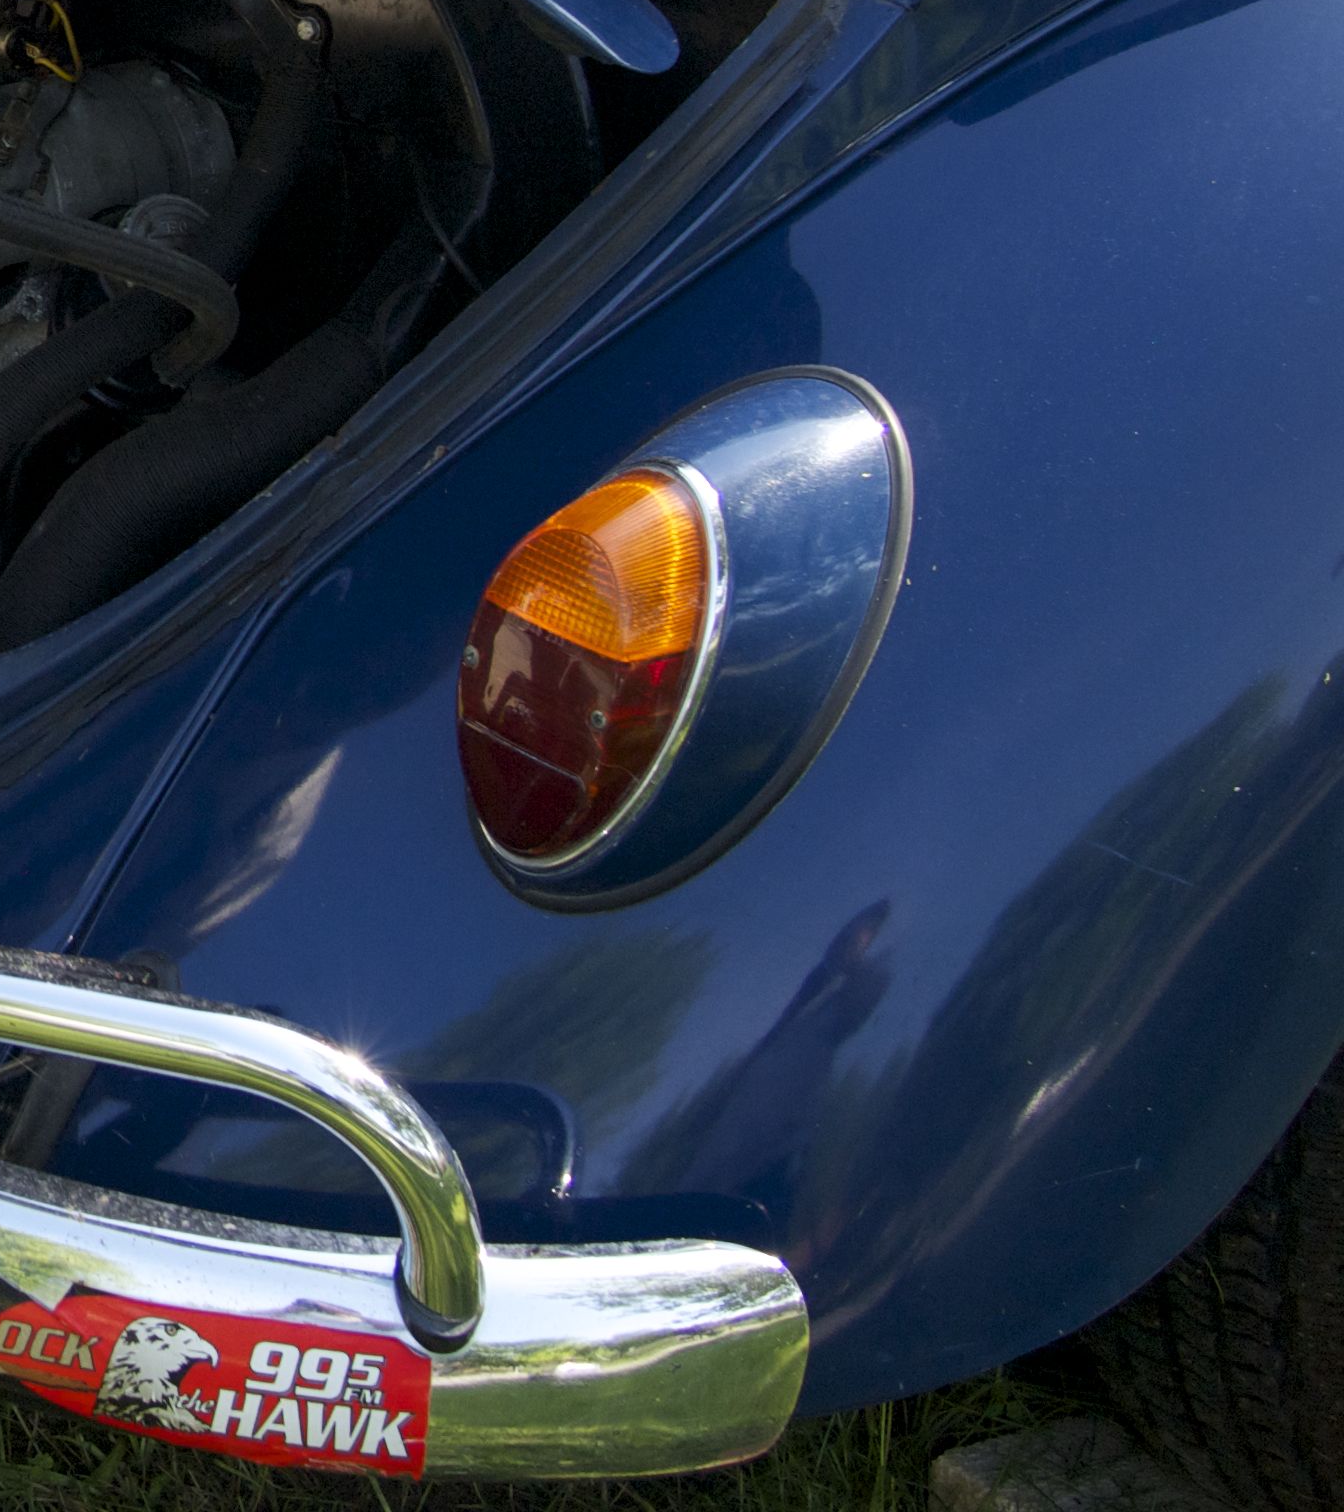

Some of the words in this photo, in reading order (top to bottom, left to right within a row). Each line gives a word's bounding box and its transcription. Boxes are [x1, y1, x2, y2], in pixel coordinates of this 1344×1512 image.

[343, 1387, 382, 1405] FM
[177, 1389, 215, 1414] the
[211, 1388, 413, 1458] HAWK
